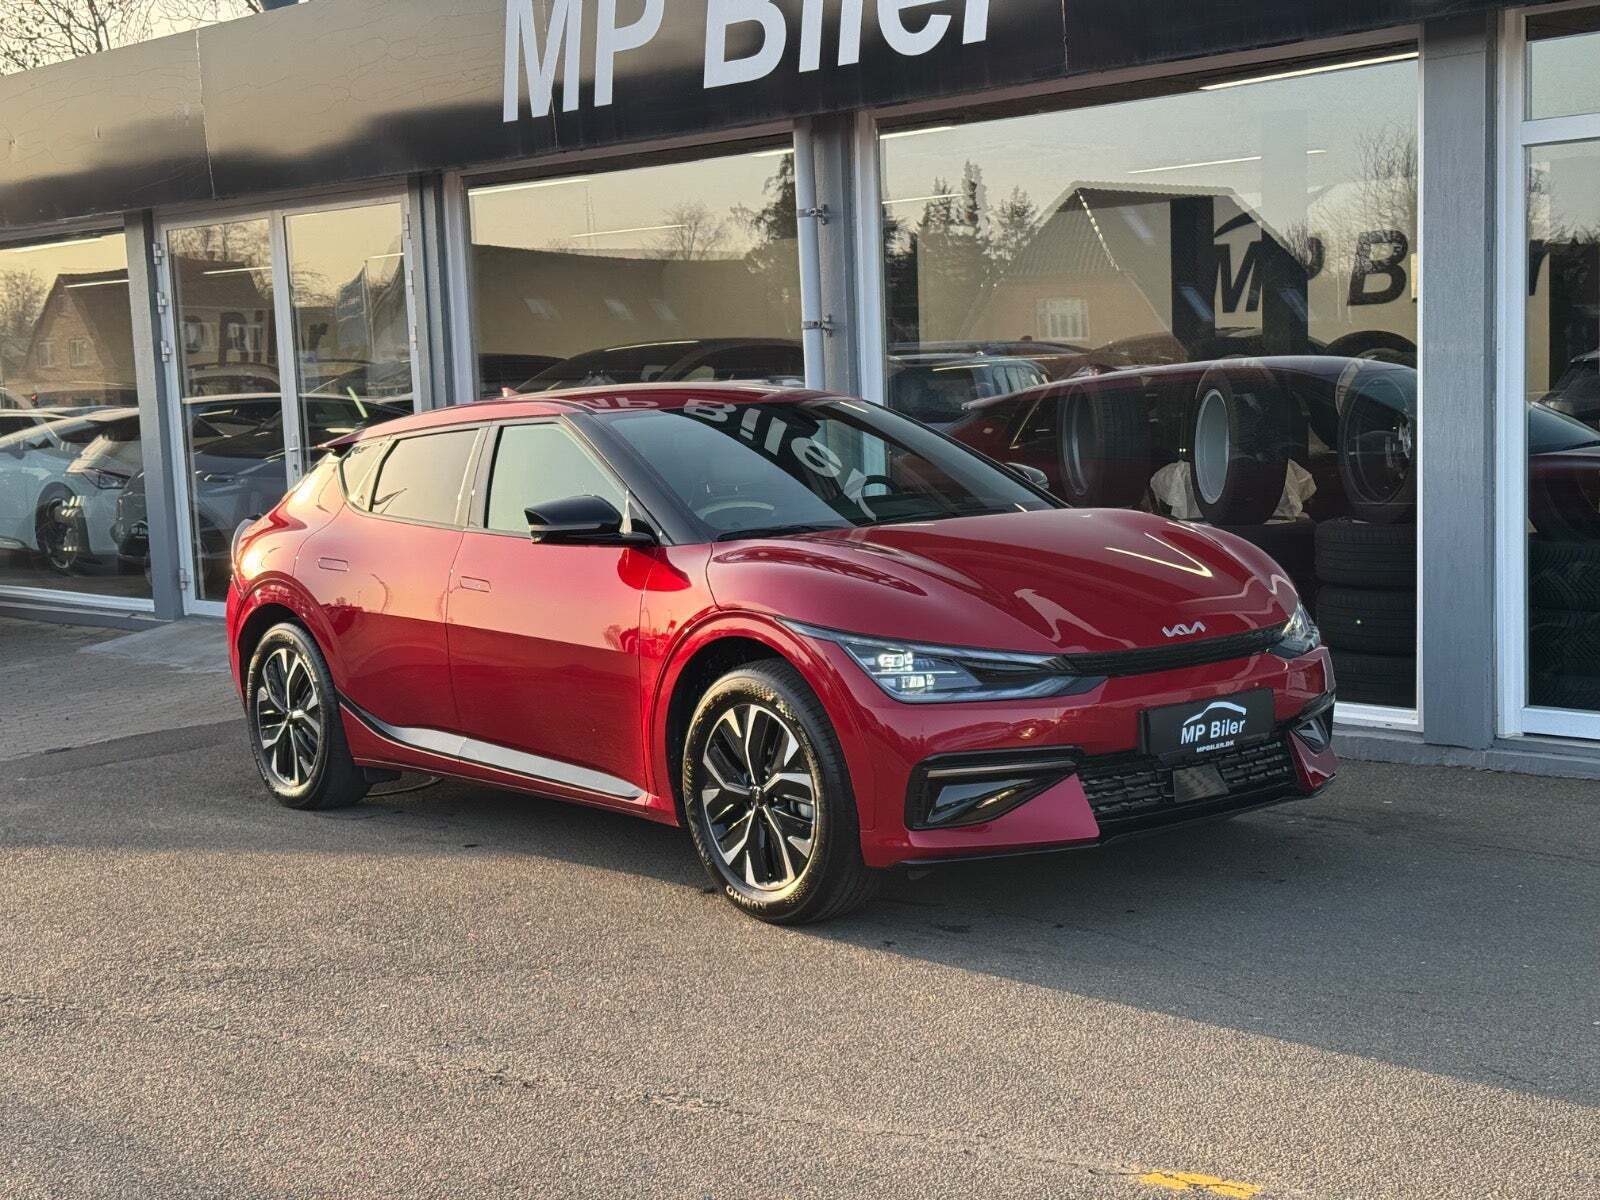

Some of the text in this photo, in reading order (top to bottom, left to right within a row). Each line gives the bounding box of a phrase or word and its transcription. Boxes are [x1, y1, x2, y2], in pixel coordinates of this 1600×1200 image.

[502, 0, 664, 123] MP
[1180, 718, 1246, 745] MP Biler
[726, 885, 768, 911] KUMHO
